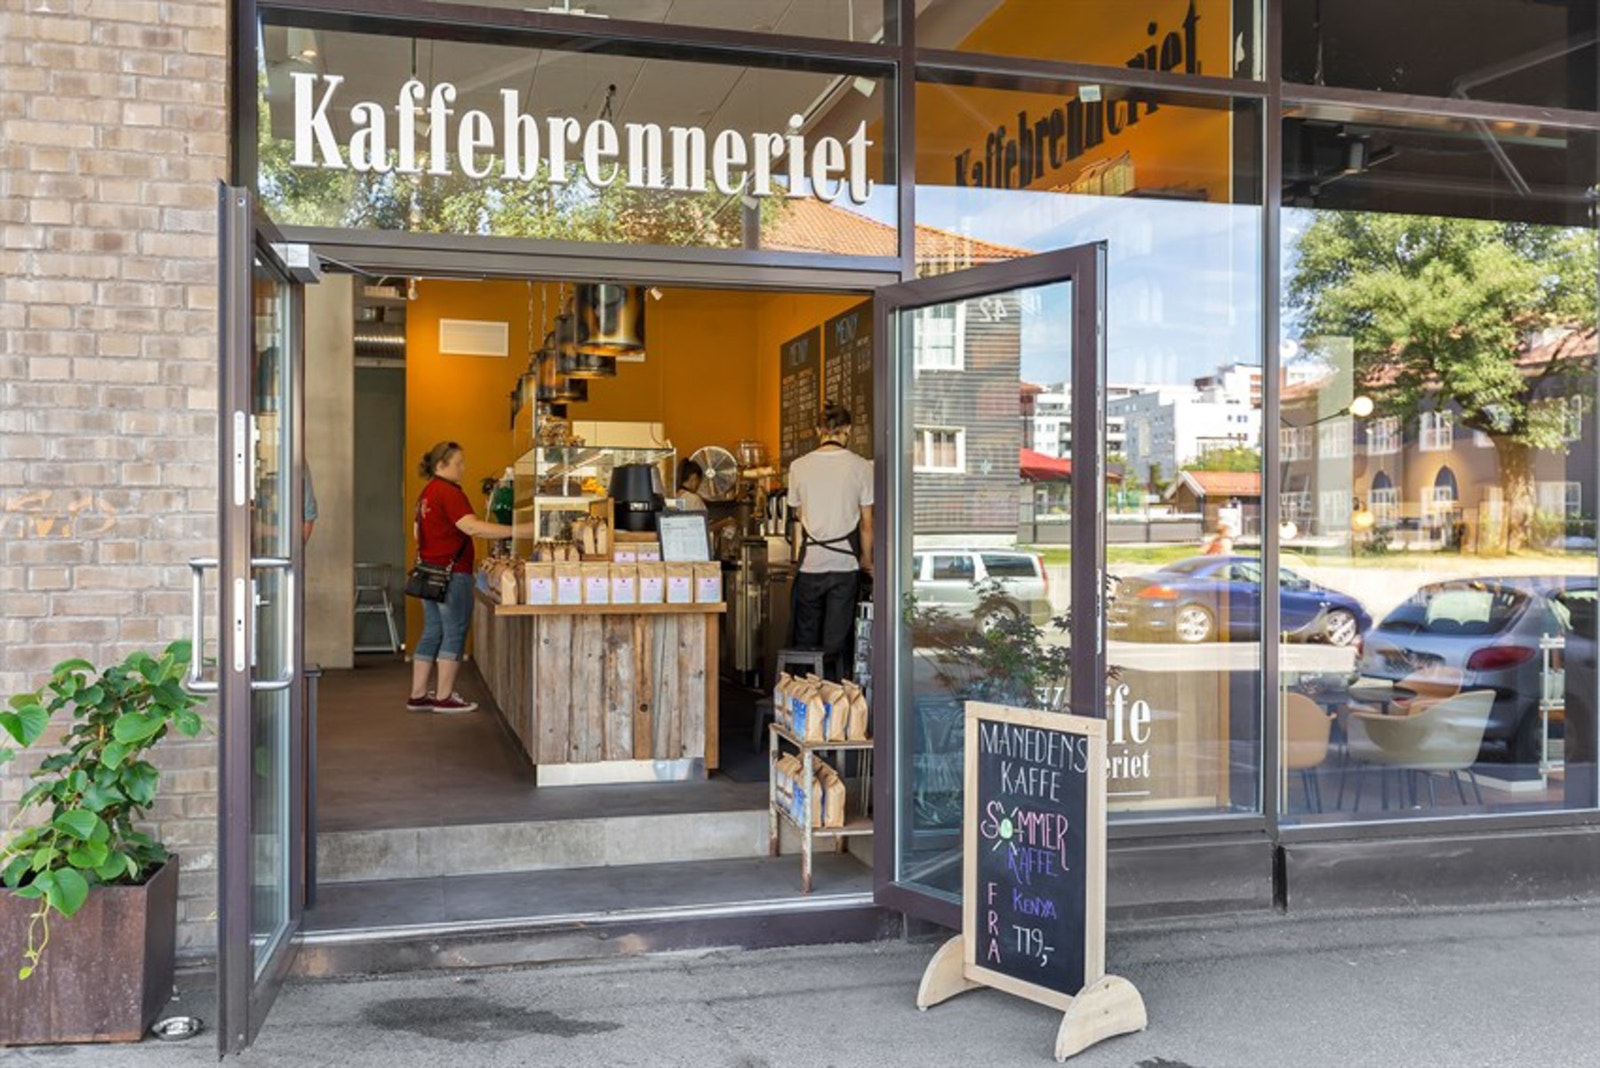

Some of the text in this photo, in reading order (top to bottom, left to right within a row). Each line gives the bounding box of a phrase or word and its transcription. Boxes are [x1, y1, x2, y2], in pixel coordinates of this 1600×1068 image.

[290, 71, 874, 204] Kaffebrenneriet
[980, 721, 1088, 773] MÅNEDENS
[1001, 761, 1062, 803] KAFFE
[1007, 846, 1060, 886] KAFFE
